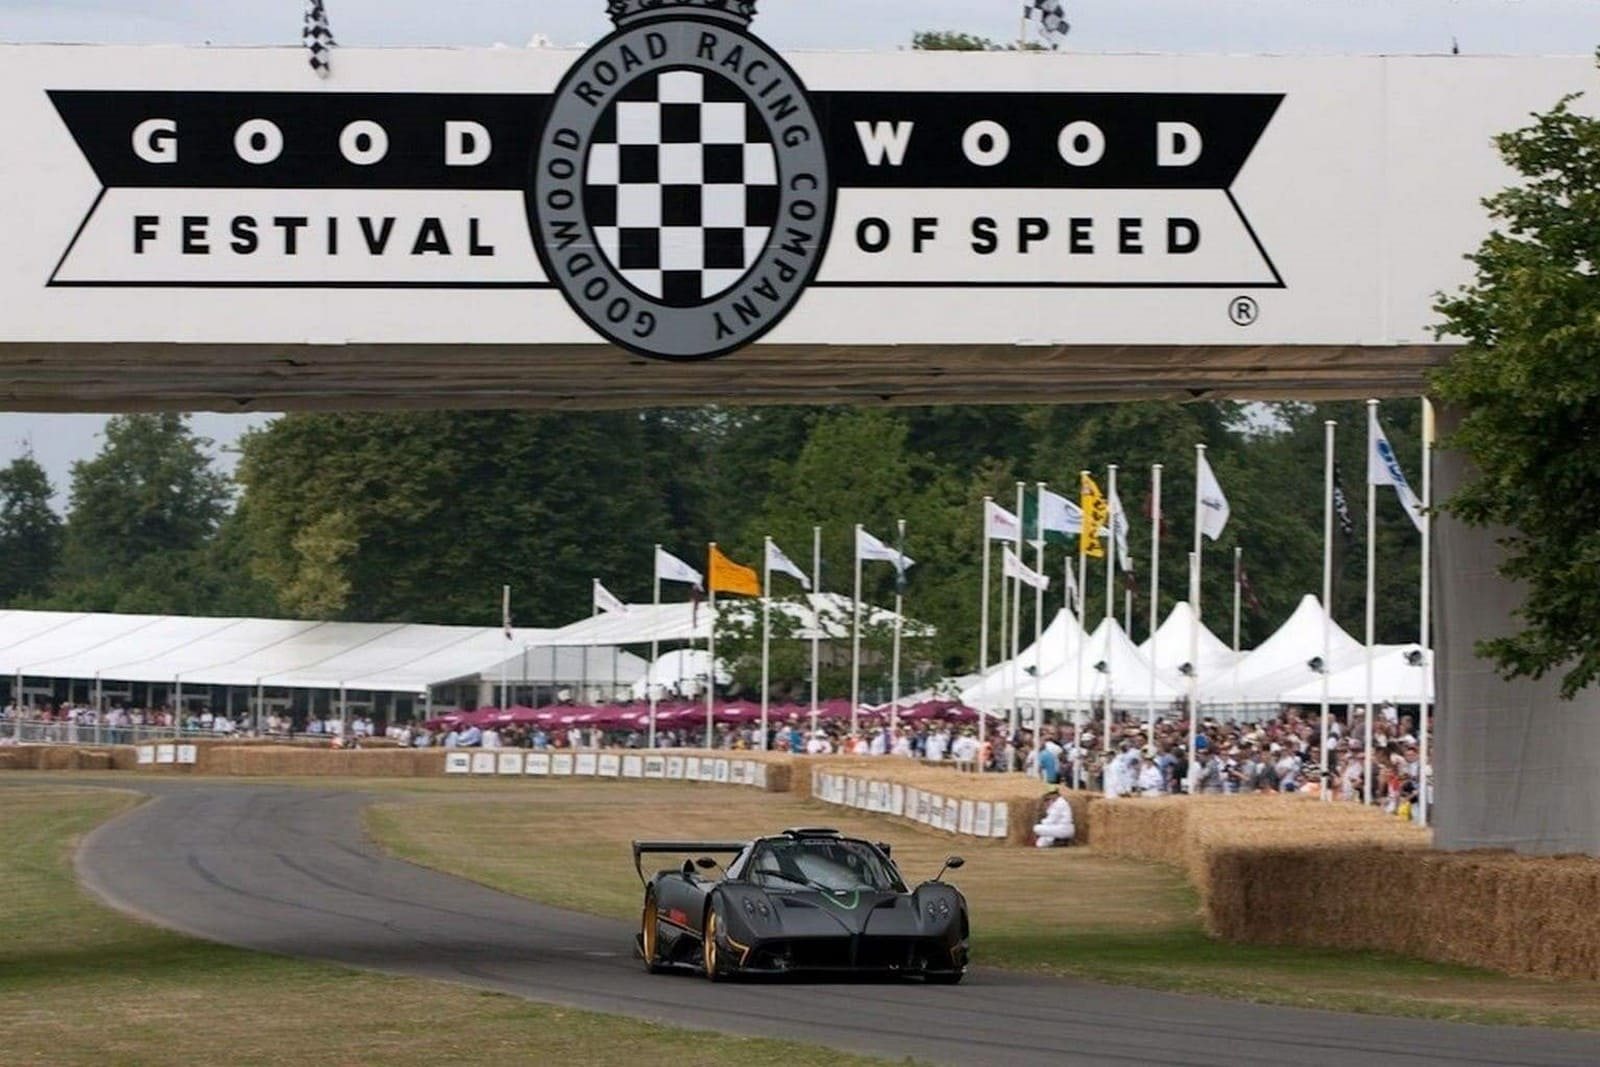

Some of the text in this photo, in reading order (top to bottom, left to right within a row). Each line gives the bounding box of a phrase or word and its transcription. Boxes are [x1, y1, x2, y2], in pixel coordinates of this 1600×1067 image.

[133, 215, 1201, 257] FESTIVAL OF SPEED
[547, 31, 818, 340] GOODWOOD ROAD RACING COMPANY
